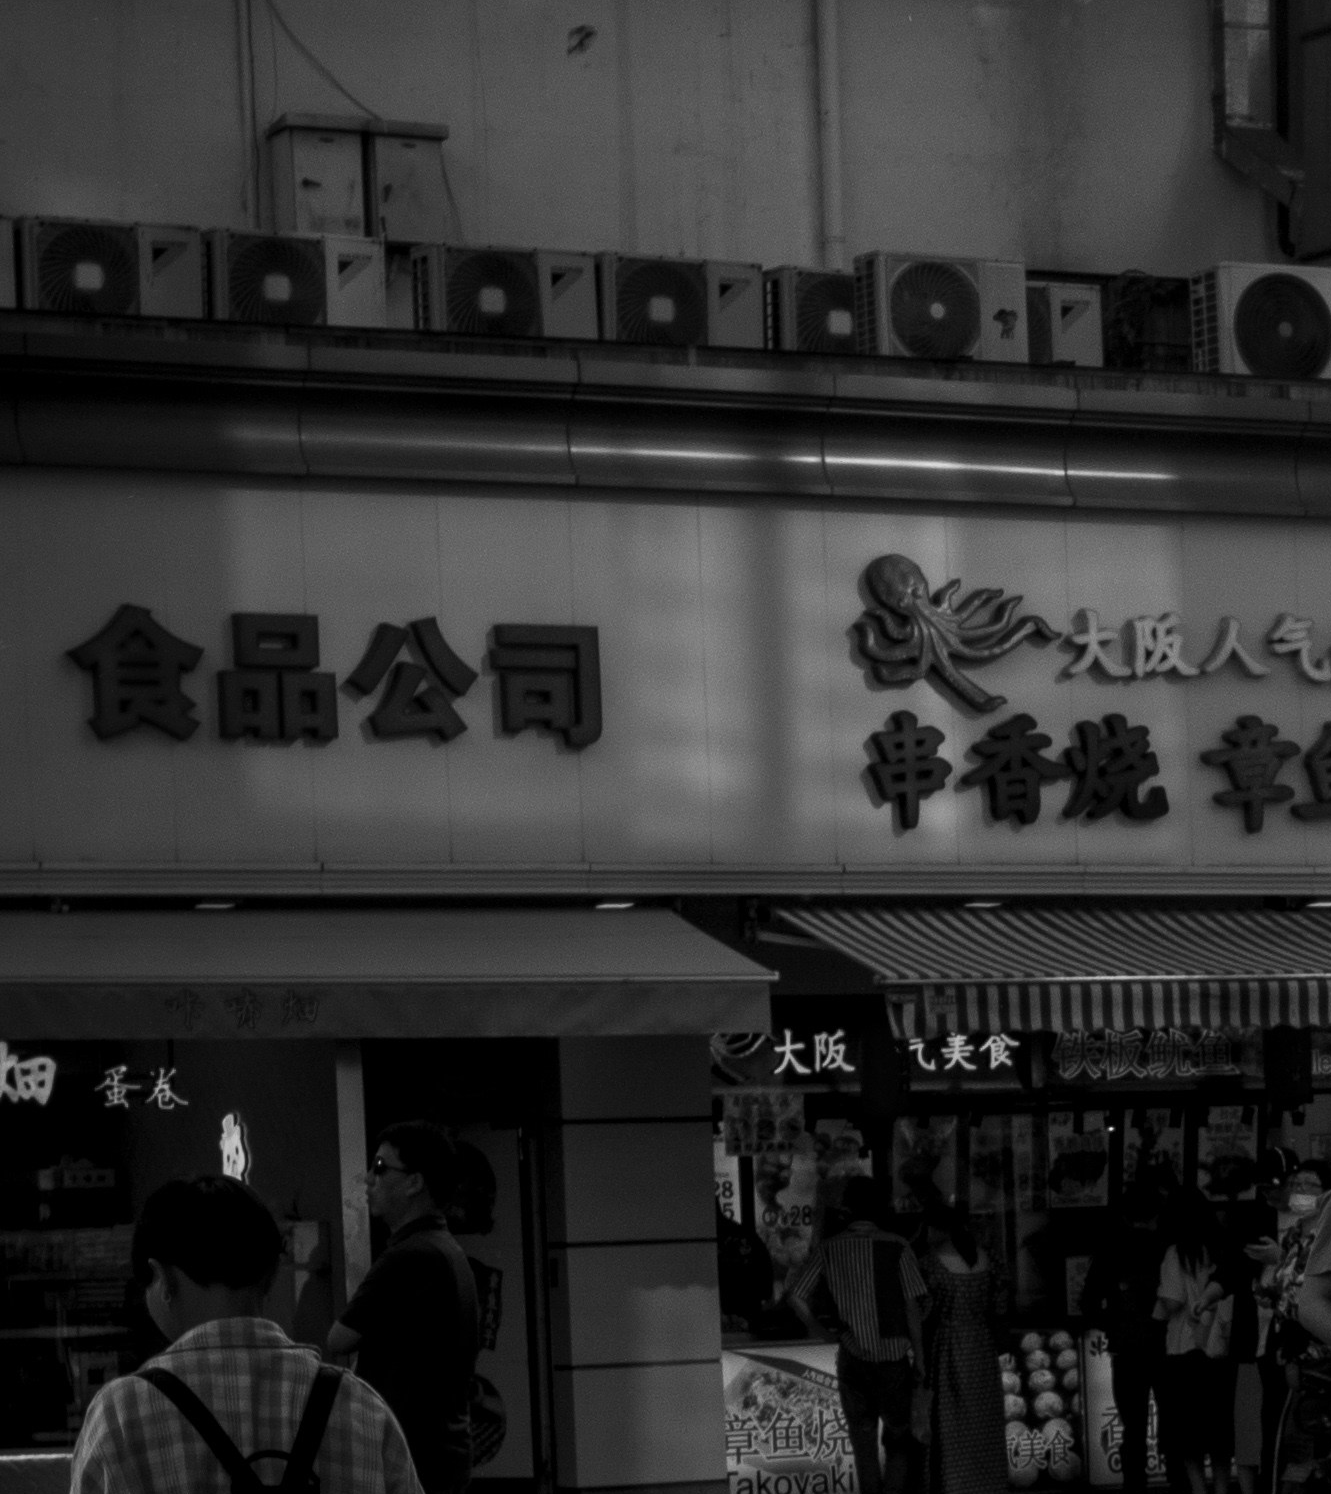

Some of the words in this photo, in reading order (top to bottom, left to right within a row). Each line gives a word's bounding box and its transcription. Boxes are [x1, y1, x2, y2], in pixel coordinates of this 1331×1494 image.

[66, 603, 603, 749] 食品公司
[865, 709, 1171, 831] 串香烧
[93, 1063, 190, 1111] 蛋卷
[725, 1406, 854, 1465] 章鱼烧
